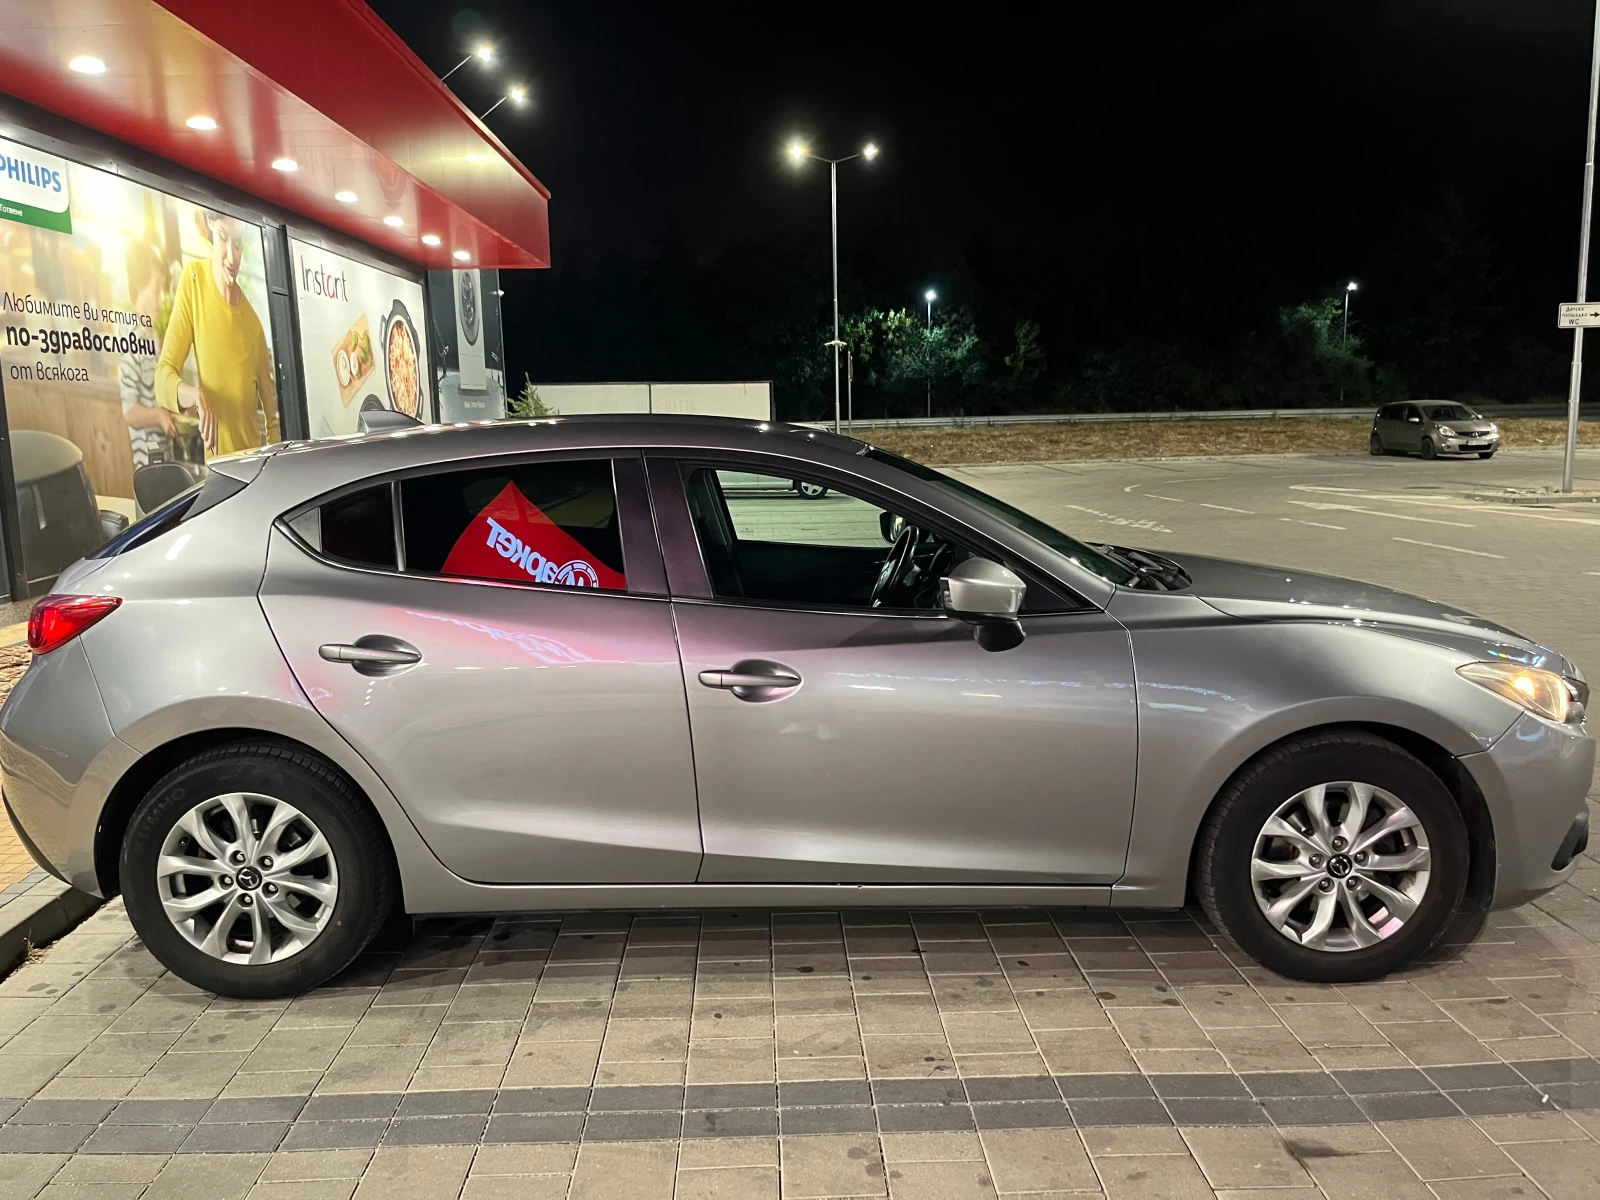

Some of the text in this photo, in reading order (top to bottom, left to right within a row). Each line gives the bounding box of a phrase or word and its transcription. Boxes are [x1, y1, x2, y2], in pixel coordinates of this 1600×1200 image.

[300, 254, 349, 302] Instant
[3, 291, 153, 328] Любимите ви ястия са
[6, 325, 156, 356] по-здравословни
[10, 361, 90, 382] от всякога
